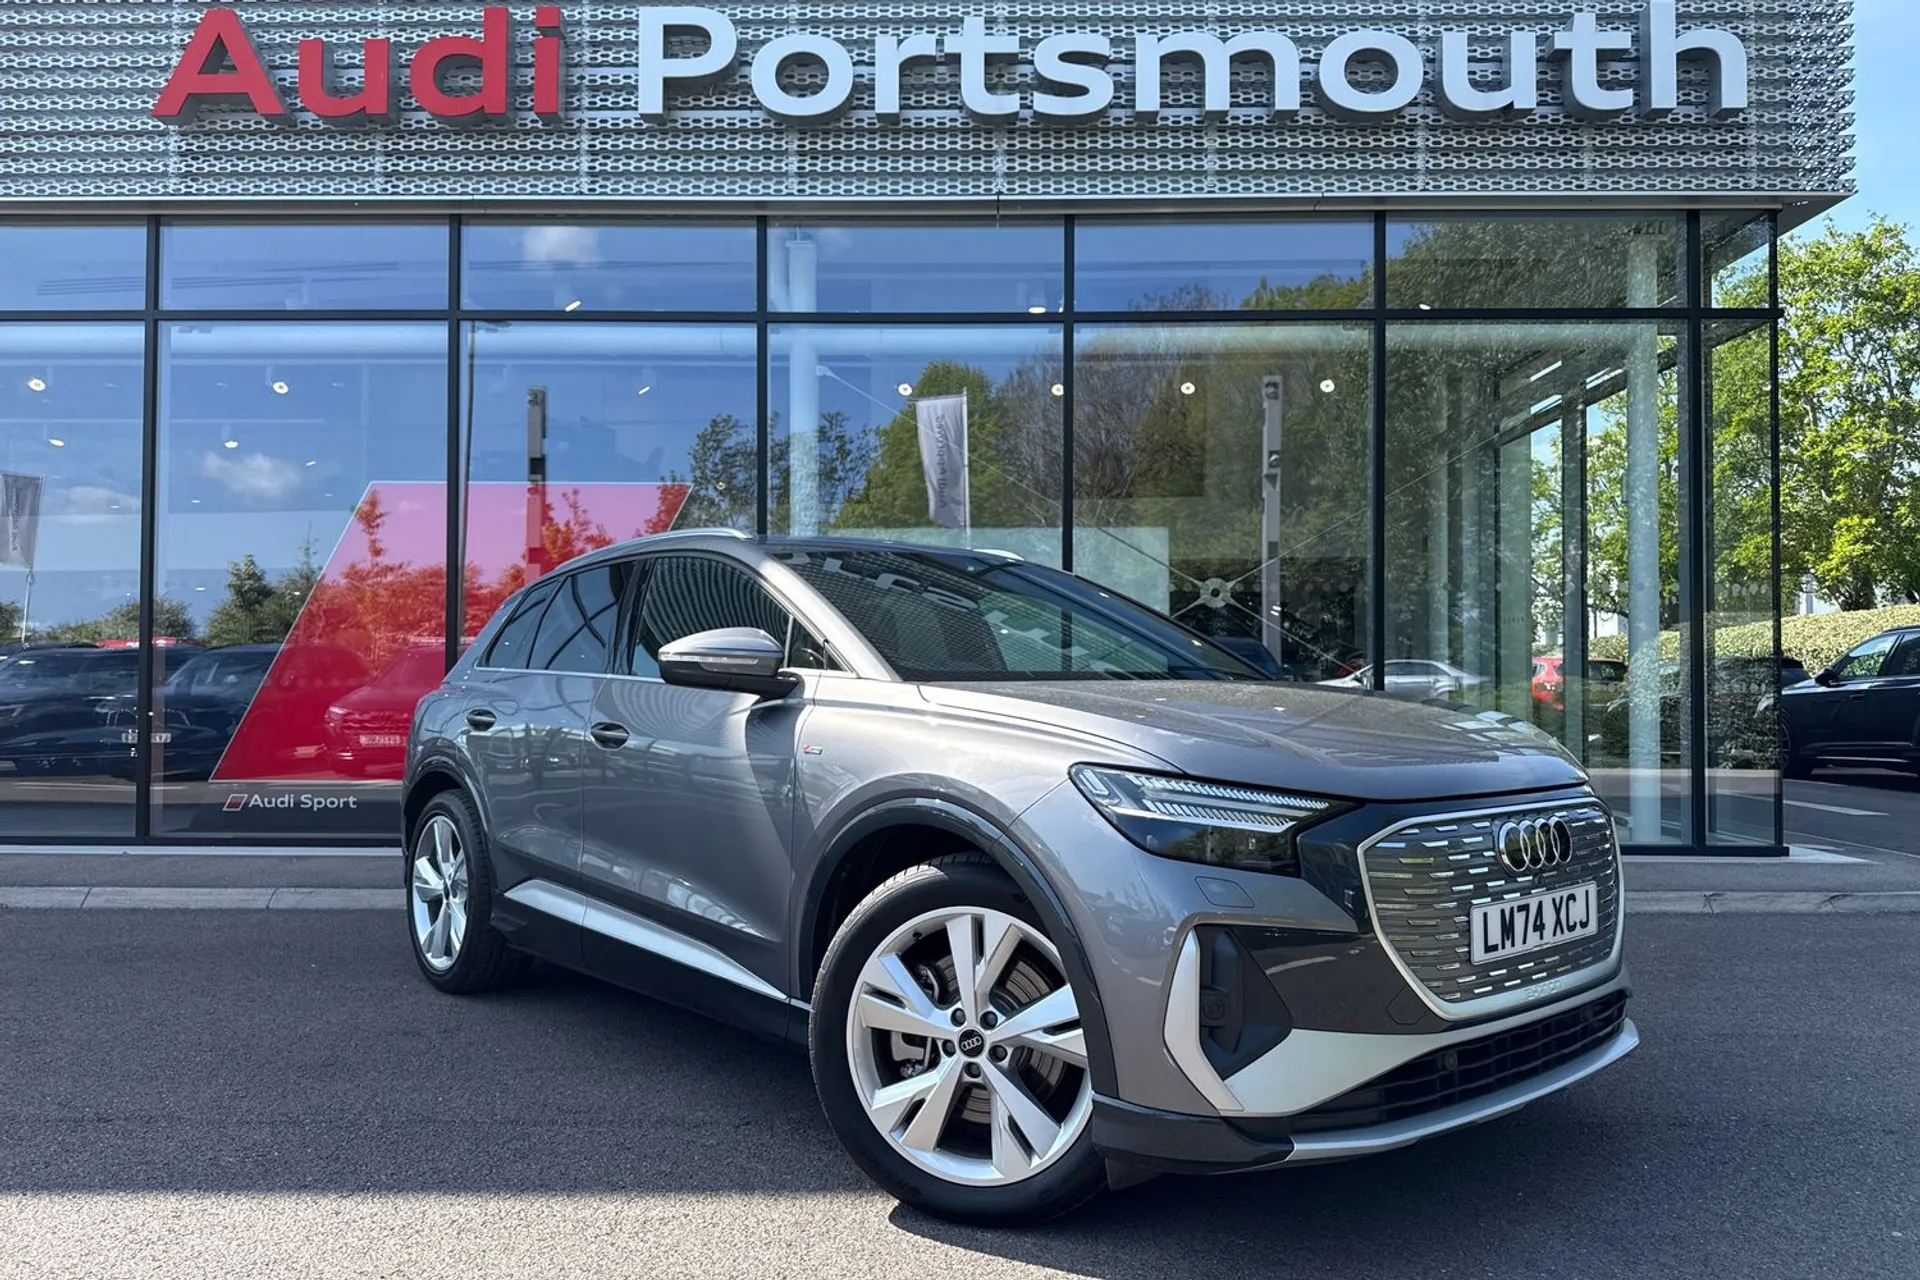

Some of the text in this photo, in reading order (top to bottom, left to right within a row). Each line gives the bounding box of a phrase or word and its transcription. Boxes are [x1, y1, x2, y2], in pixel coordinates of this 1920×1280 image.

[152, 0, 1748, 121] Audi Portsmouth
[248, 793, 358, 812] Audi Sport
[1482, 888, 1591, 955] LM74 XCJ
